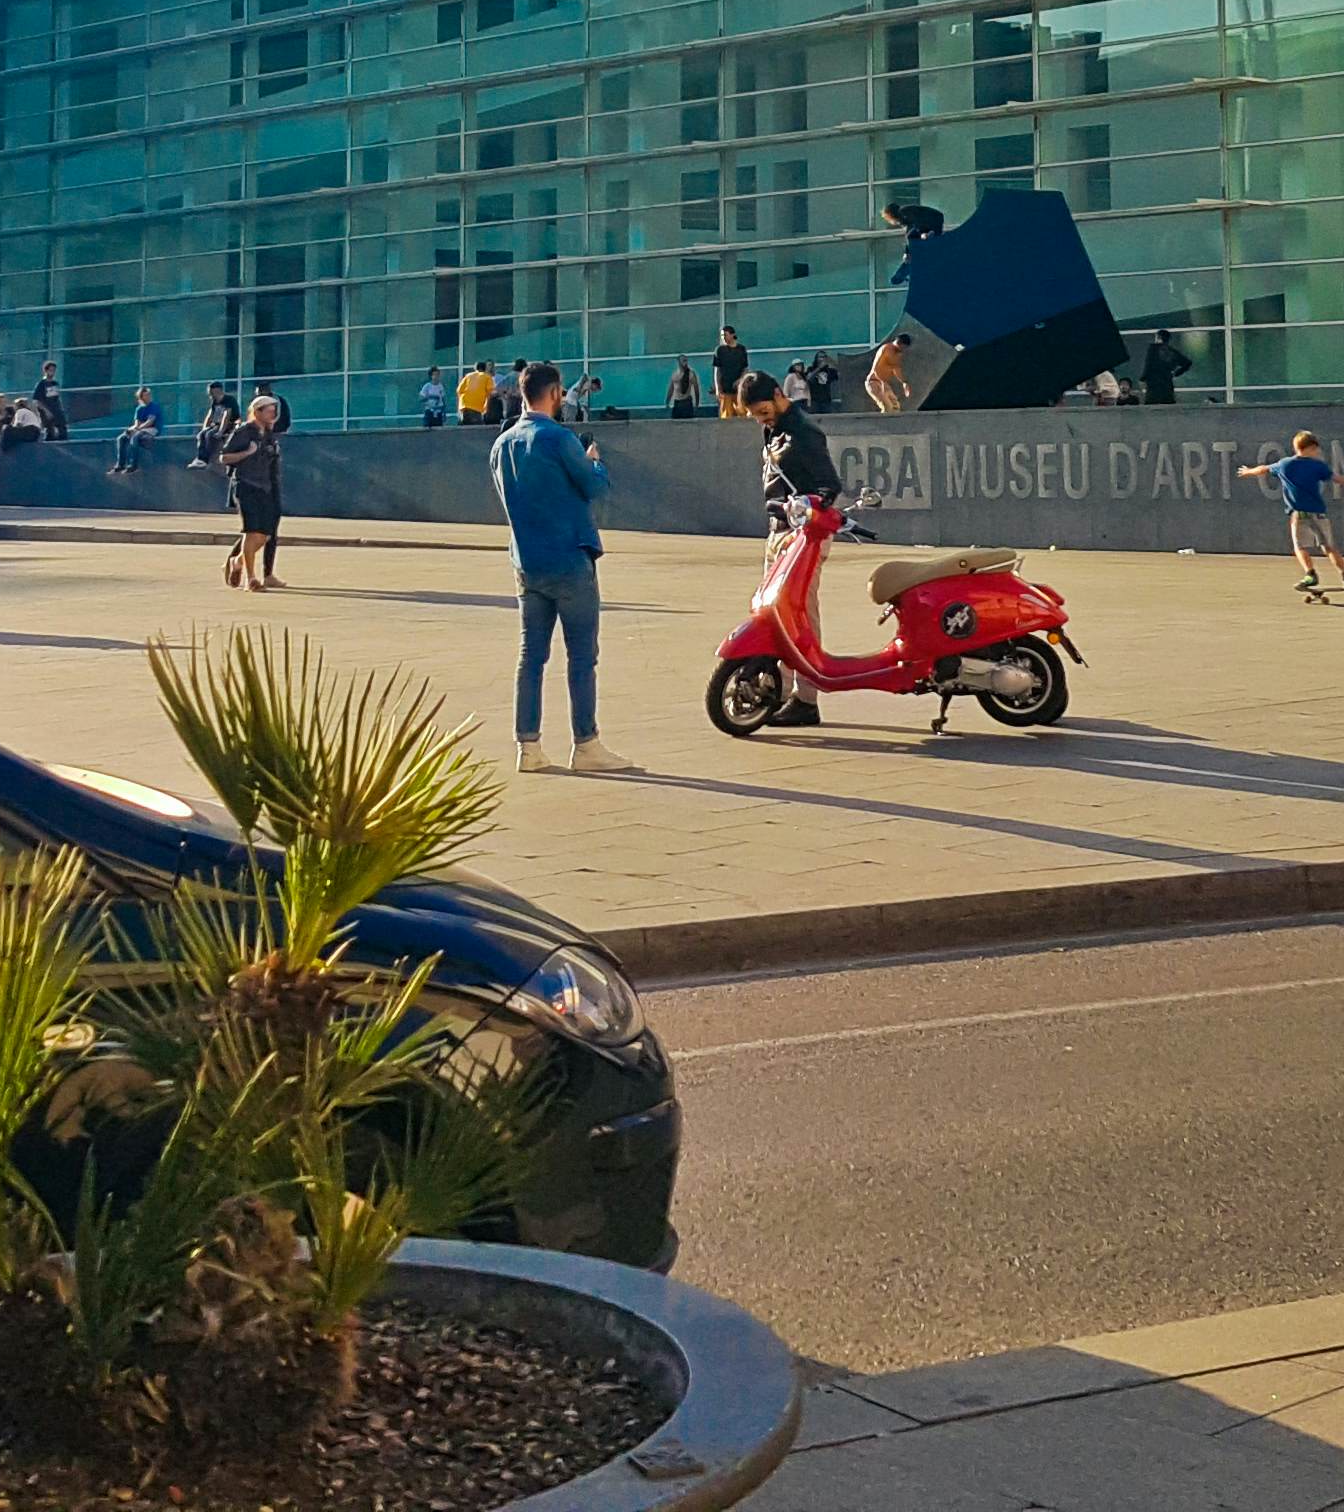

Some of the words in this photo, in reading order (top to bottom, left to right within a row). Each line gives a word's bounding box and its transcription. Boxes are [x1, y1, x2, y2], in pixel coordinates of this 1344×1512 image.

[838, 445, 924, 500] CBA
[945, 441, 1090, 500] MUSEU
[1109, 439, 1238, 500] D'ART
